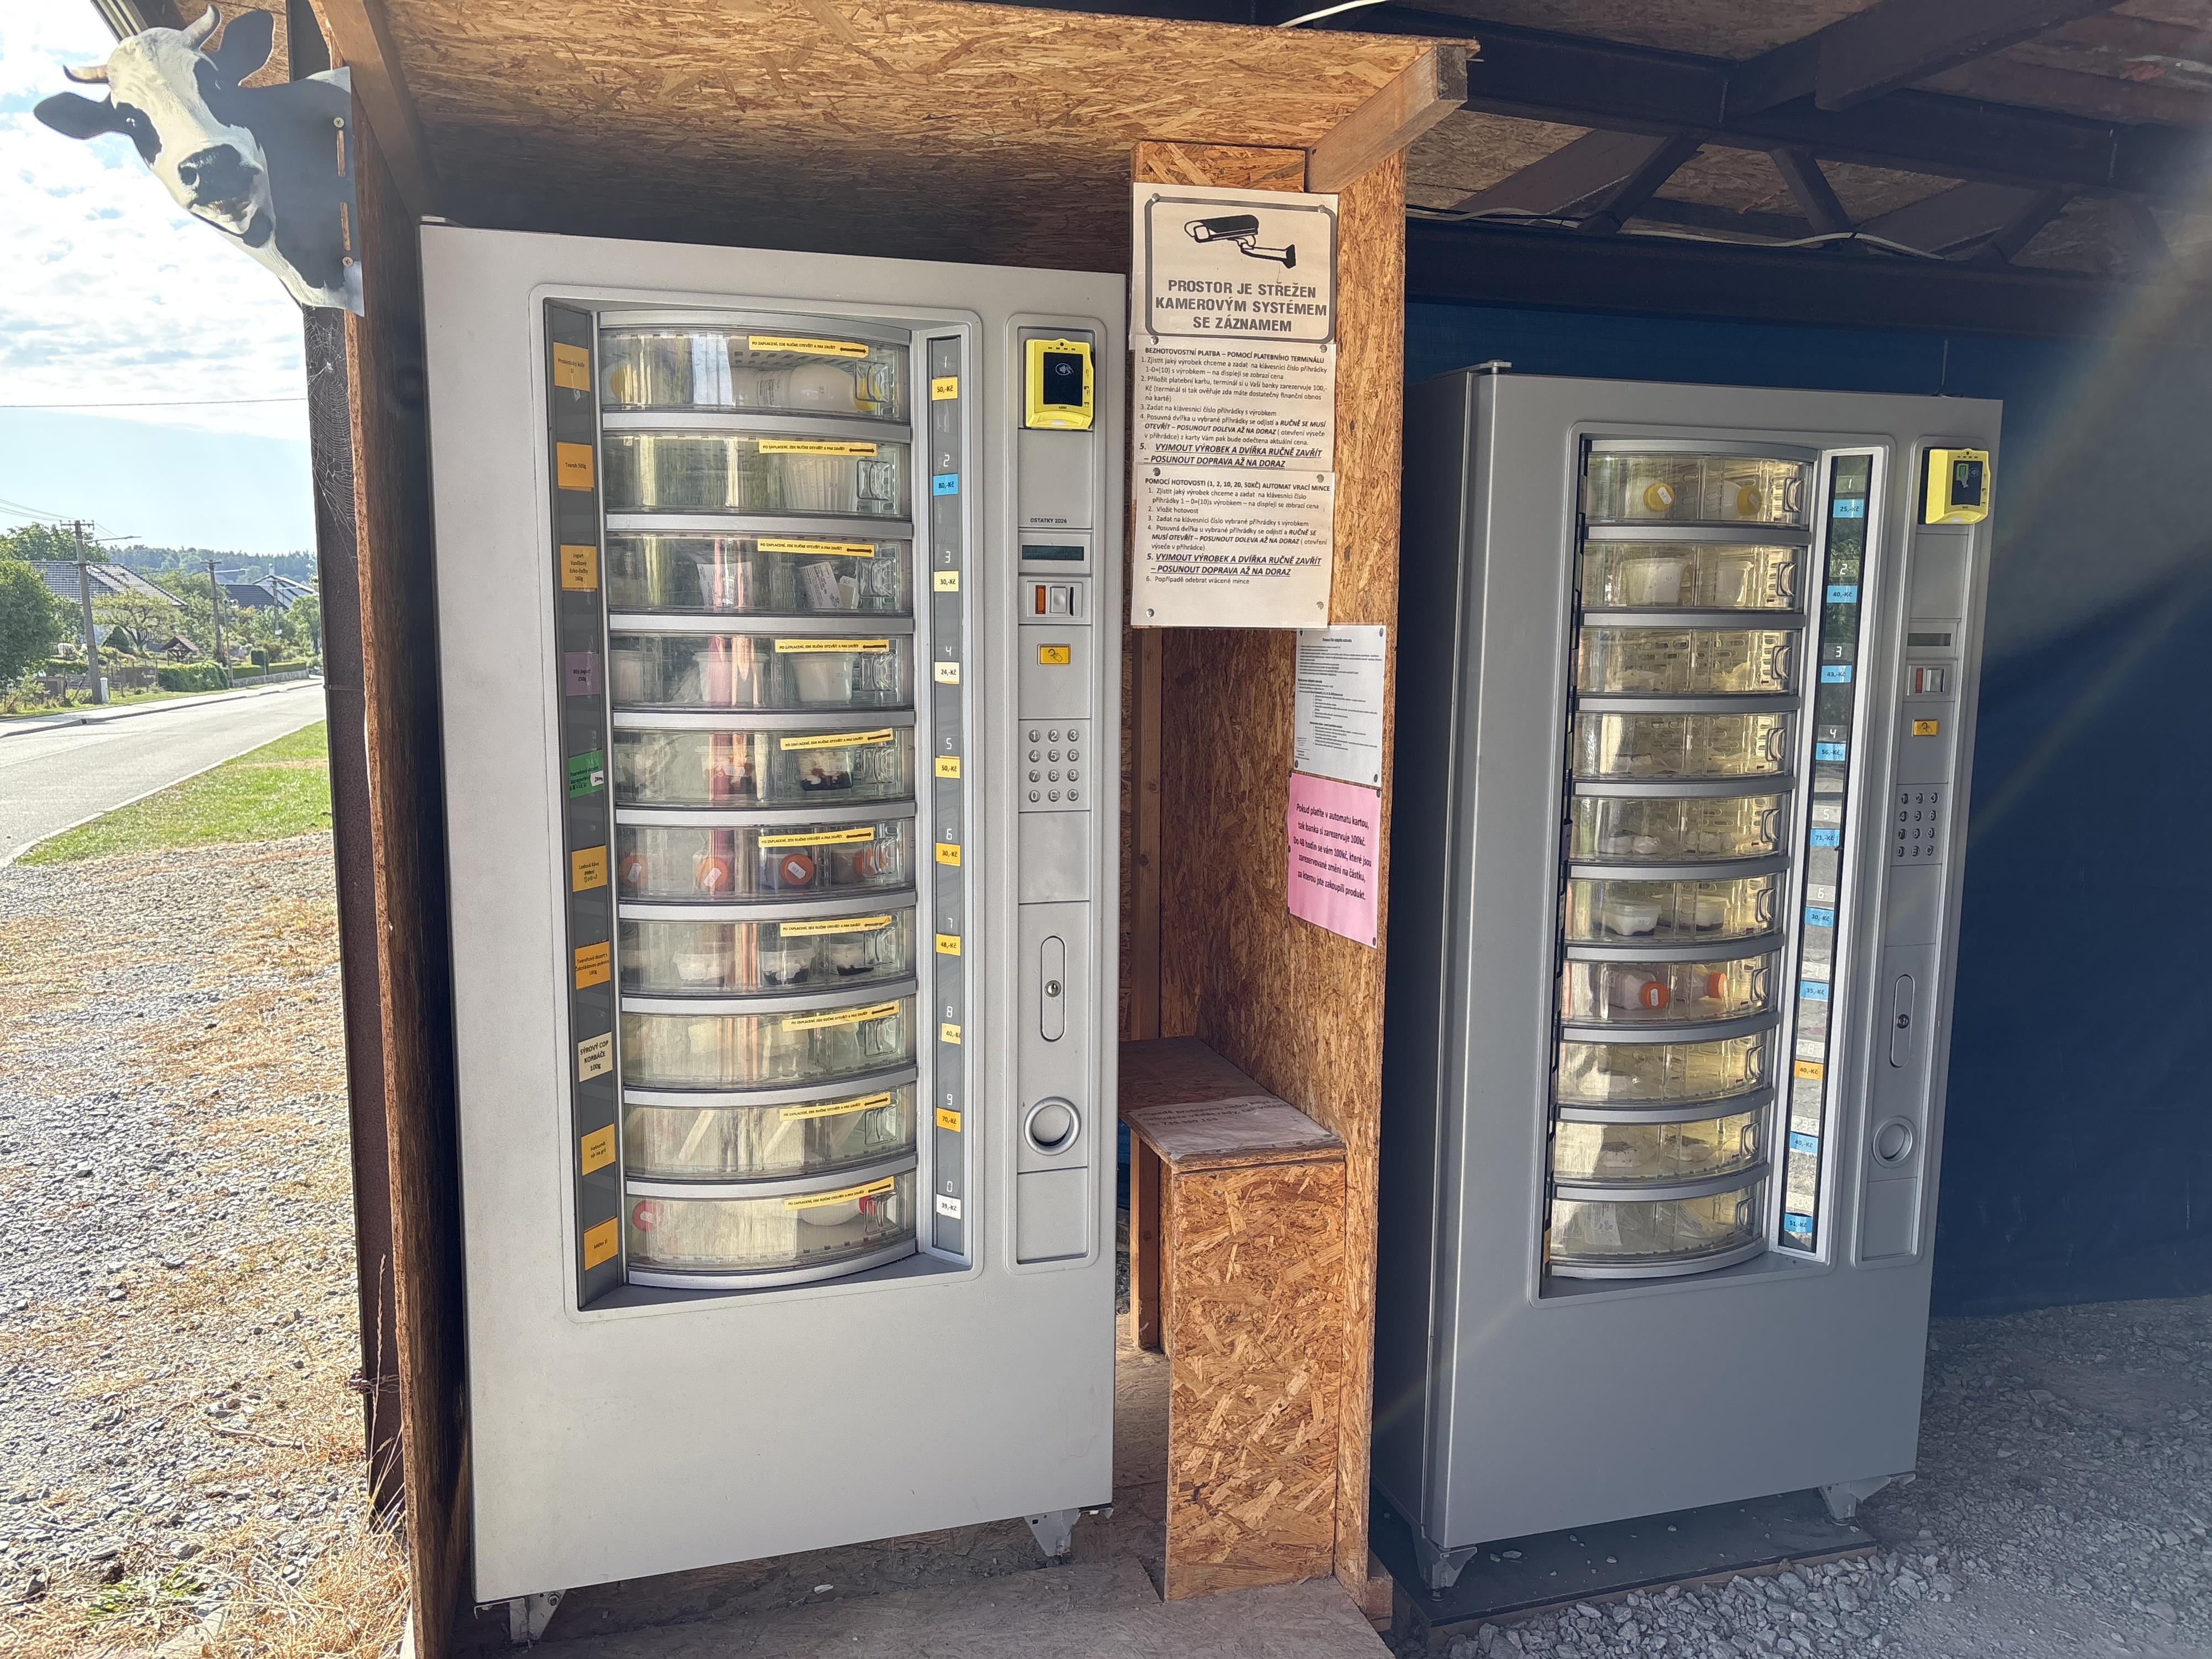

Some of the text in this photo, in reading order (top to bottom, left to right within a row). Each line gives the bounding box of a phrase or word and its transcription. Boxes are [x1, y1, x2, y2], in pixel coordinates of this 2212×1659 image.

[1168, 280, 1316, 298] PROSTOR JE STŘEŽEN
[1156, 296, 1327, 316] KAMEROVÝM SYSTÉMEM
[1193, 314, 1292, 332] SE ZÁZNAMEM
[1145, 347, 1196, 356] BEZHOTOVOSTNÍ
[1253, 353, 1289, 361] PLATEBNÍHO
[1290, 355, 1324, 363] TERMINÁLU
[944, 355, 948, 368] 1
[1164, 357, 1177, 366] jaký
[1177, 357, 1202, 367] výrobek
[1259, 362, 1285, 371] klávesnici
[1300, 365, 1327, 374] přihrádky
[937, 385, 953, 393] 50,-Kč
[1155, 443, 1193, 451] VYJMOUT
[1195, 444, 1230, 453] VÝROBEK
[1238, 445, 1266, 455] DVÍŘKA
[1268, 446, 1295, 456] RUČNĚ
[1295, 447, 1323, 456] ZAVŘÍT
[943, 453, 950, 467] 2
[1151, 455, 1194, 463] POSUNOUT
[1194, 457, 1233, 466] DOPRAVA
[1234, 457, 1245, 466] AŽ
[1259, 459, 1286, 467] DORAZ
[938, 481, 954, 489] 80,-Kč
[1244, 481, 1260, 489] 50KČ)
[1848, 478, 1852, 489] 1
[945, 550, 951, 564] 3
[1155, 553, 1192, 562] VYJMOUT
[1238, 554, 1266, 563] DVÍŘKA
[1268, 555, 1295, 564] RUČNĚ
[1295, 556, 1322, 565] ZAVŘÍT
[1157, 565, 1201, 573] POSUNOUT
[1239, 566, 1250, 574] AŽ
[1839, 563, 1848, 575] 2
[945, 646, 952, 657] 4
[1835, 646, 1843, 658] 3
[1829, 728, 1837, 739] 4
[946, 737, 952, 750] 5
[1296, 803, 1310, 813] Pokud
[1329, 812, 1351, 824] automatu
[1352, 815, 1369, 830] kartou,
[1823, 808, 1830, 820] 5
[946, 828, 952, 841] 6
[1319, 826, 1323, 835] si
[1323, 829, 1350, 843] zarezervuje
[1350, 834, 1365, 846] 100kč.
[1293, 836, 1298, 845] Do
[1299, 838, 1305, 847] 48
[1323, 844, 1333, 855] vám
[1333, 848, 1348, 862] 100kč,
[1349, 851, 1361, 864] které
[1362, 855, 1371, 867] jsou
[1298, 854, 1327, 869] zarezervované
[1348, 868, 1365, 883] částku,
[1302, 870, 1316, 883] kterou
[1316, 875, 1324, 886] jste
[1345, 887, 1365, 900] produkt.
[1817, 888, 1825, 899] 6
[947, 917, 953, 929] 7
[946, 1005, 953, 1018] 8
[580, 1040, 609, 1056] SÝROVÝ COP
[584, 1050, 606, 1064] KORBÁČE
[589, 1063, 602, 1072] 100g
[946, 1093, 953, 1105] 9
[942, 1116, 957, 1124] 70,-Kč
[1794, 1140, 1813, 1148] 40,-Kč
[946, 1180, 953, 1193] 0
[941, 1202, 957, 1211] 39,-Kč
[1790, 1220, 1808, 1228] 51,-Kč
